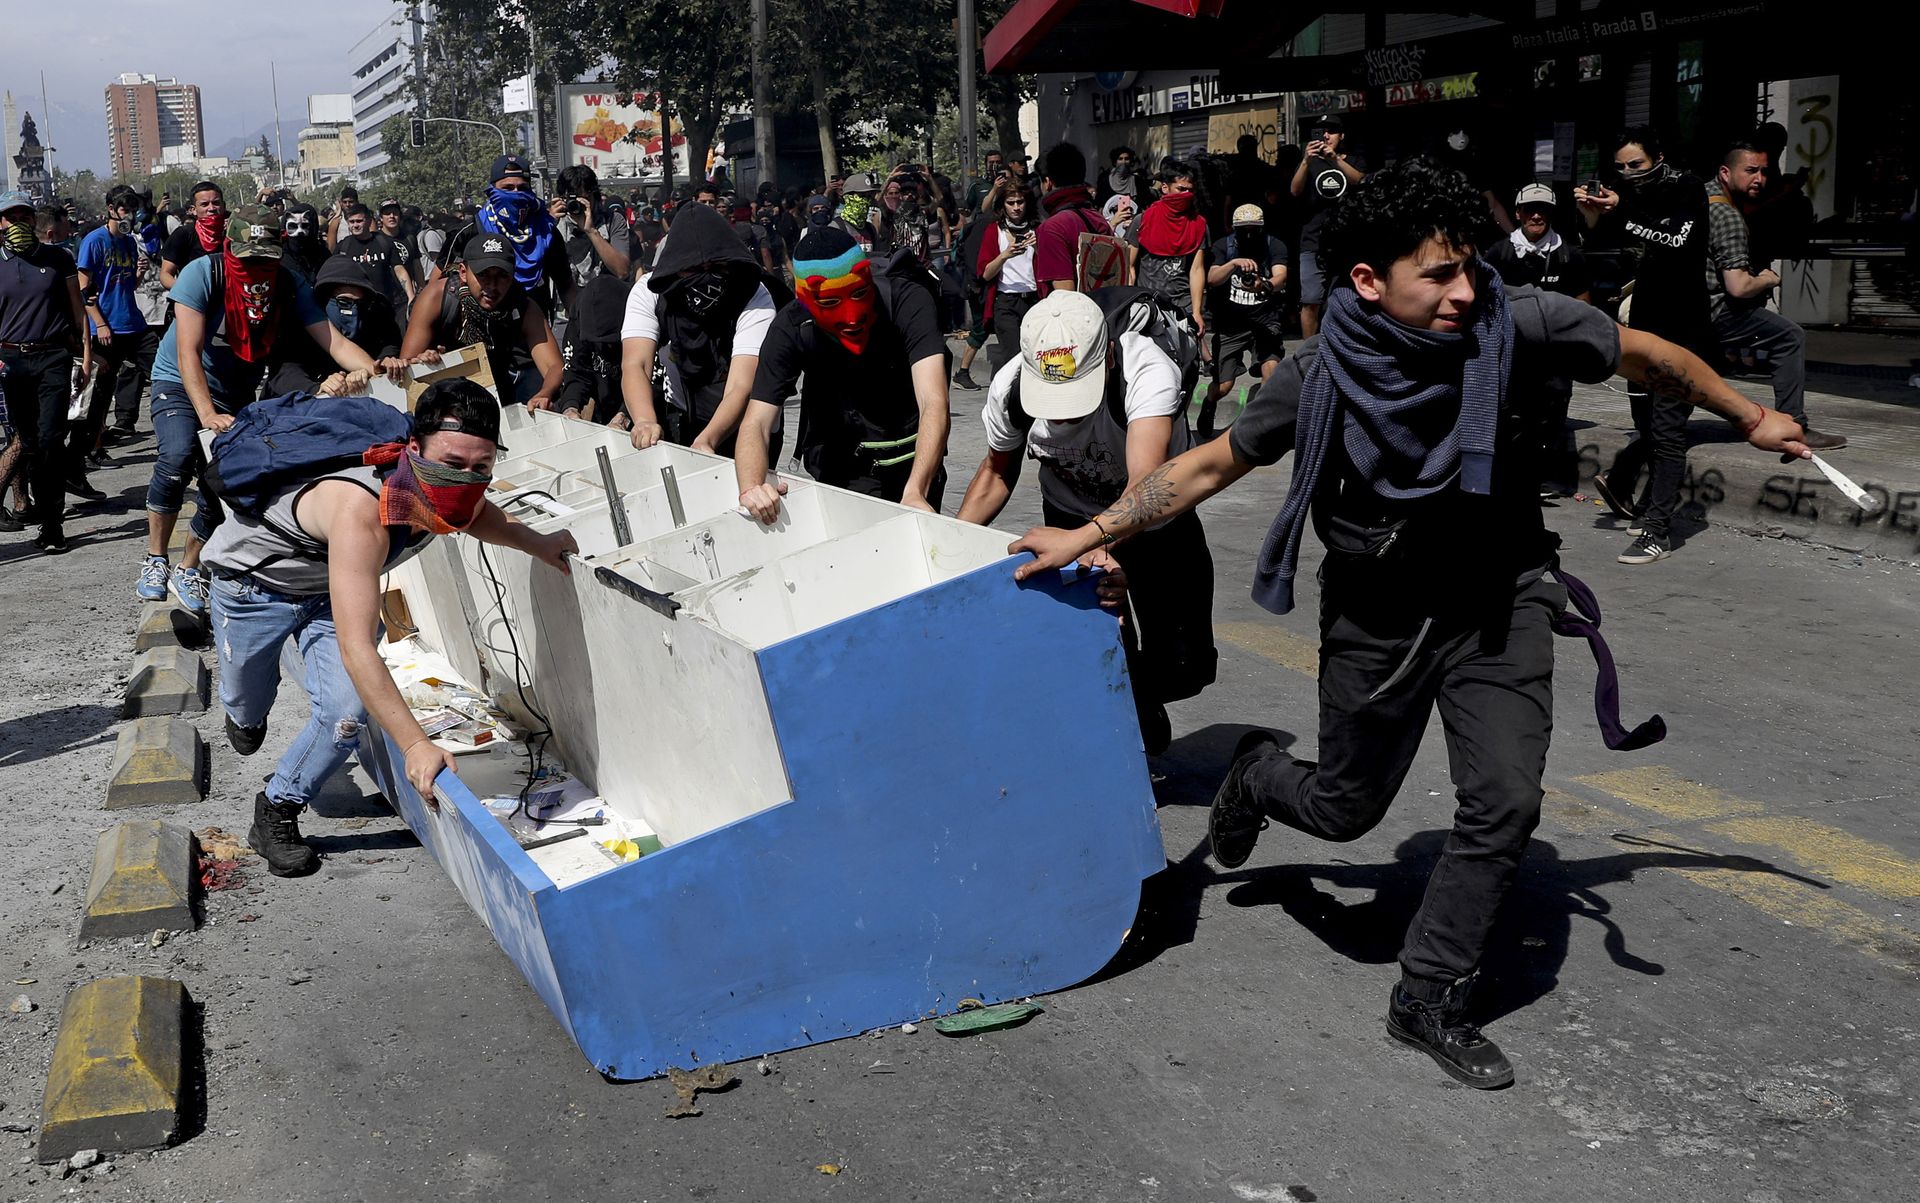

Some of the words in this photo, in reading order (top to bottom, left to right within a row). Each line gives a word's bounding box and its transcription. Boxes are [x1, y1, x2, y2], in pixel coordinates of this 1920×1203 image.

[1511, 33, 1543, 49] Plaza
[1545, 25, 1580, 45] Italia
[1592, 17, 1638, 38] Parada
[1641, 11, 1656, 31] 5
[1190, 74, 1252, 107] EVA
